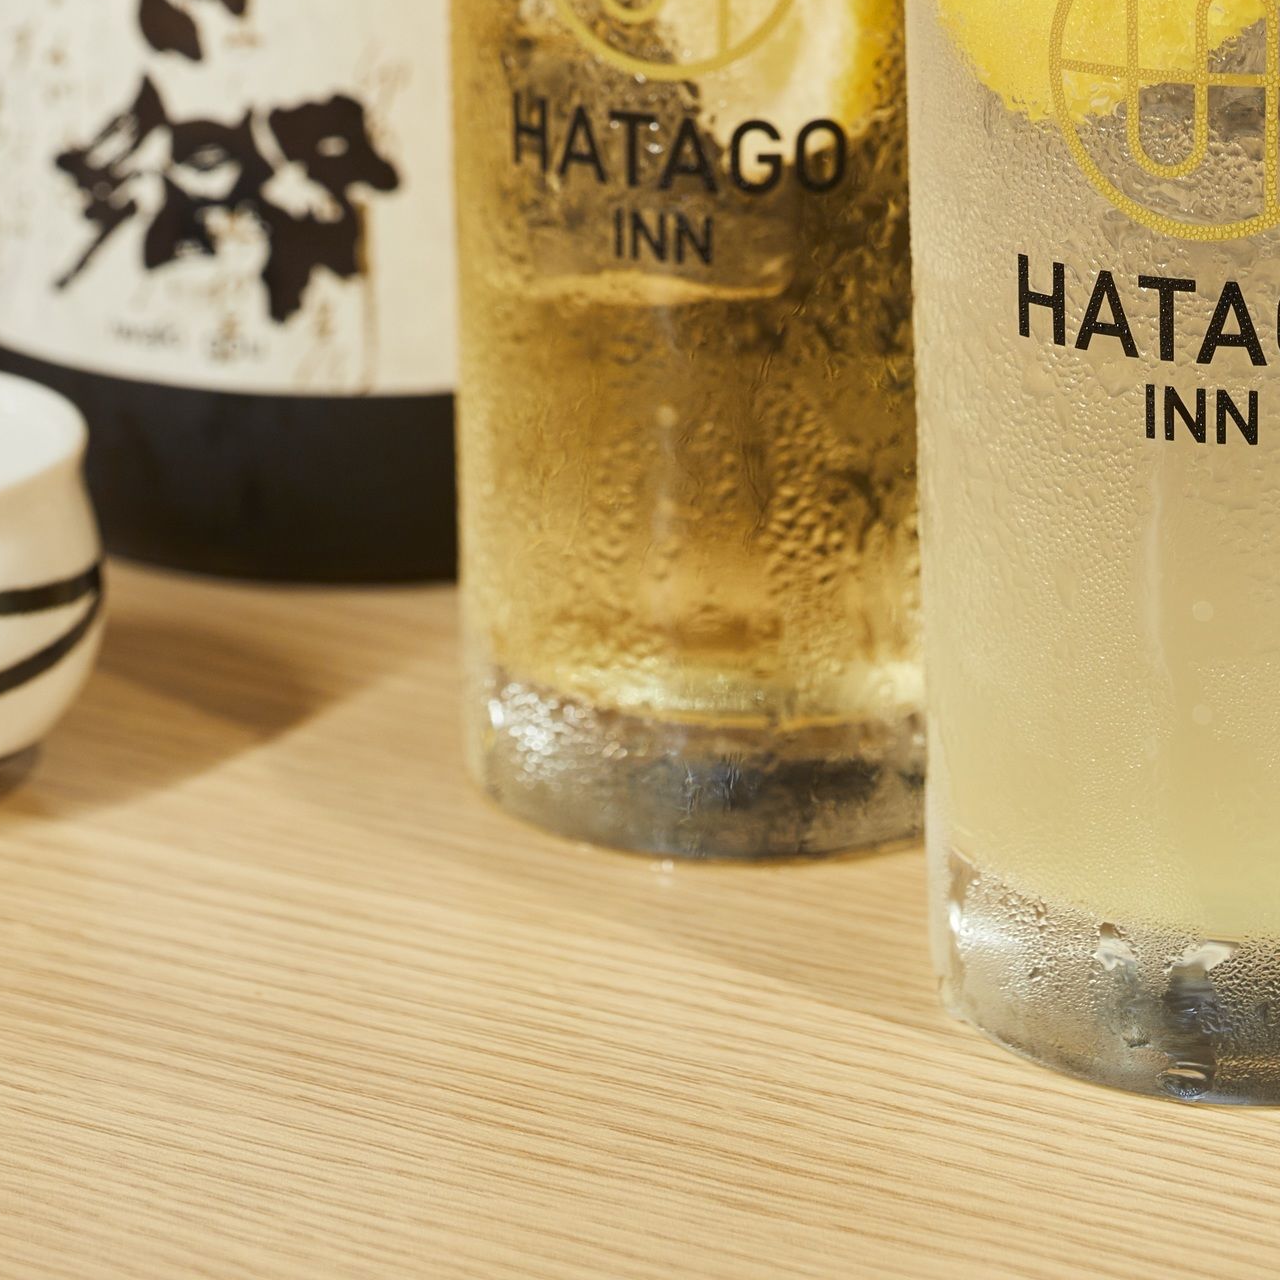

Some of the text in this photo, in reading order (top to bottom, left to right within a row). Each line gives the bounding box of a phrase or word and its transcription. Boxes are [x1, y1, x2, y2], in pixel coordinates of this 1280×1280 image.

[512, 92, 849, 196] HATAGO
[614, 207, 714, 264] INN
[1145, 383, 1260, 446] INN
